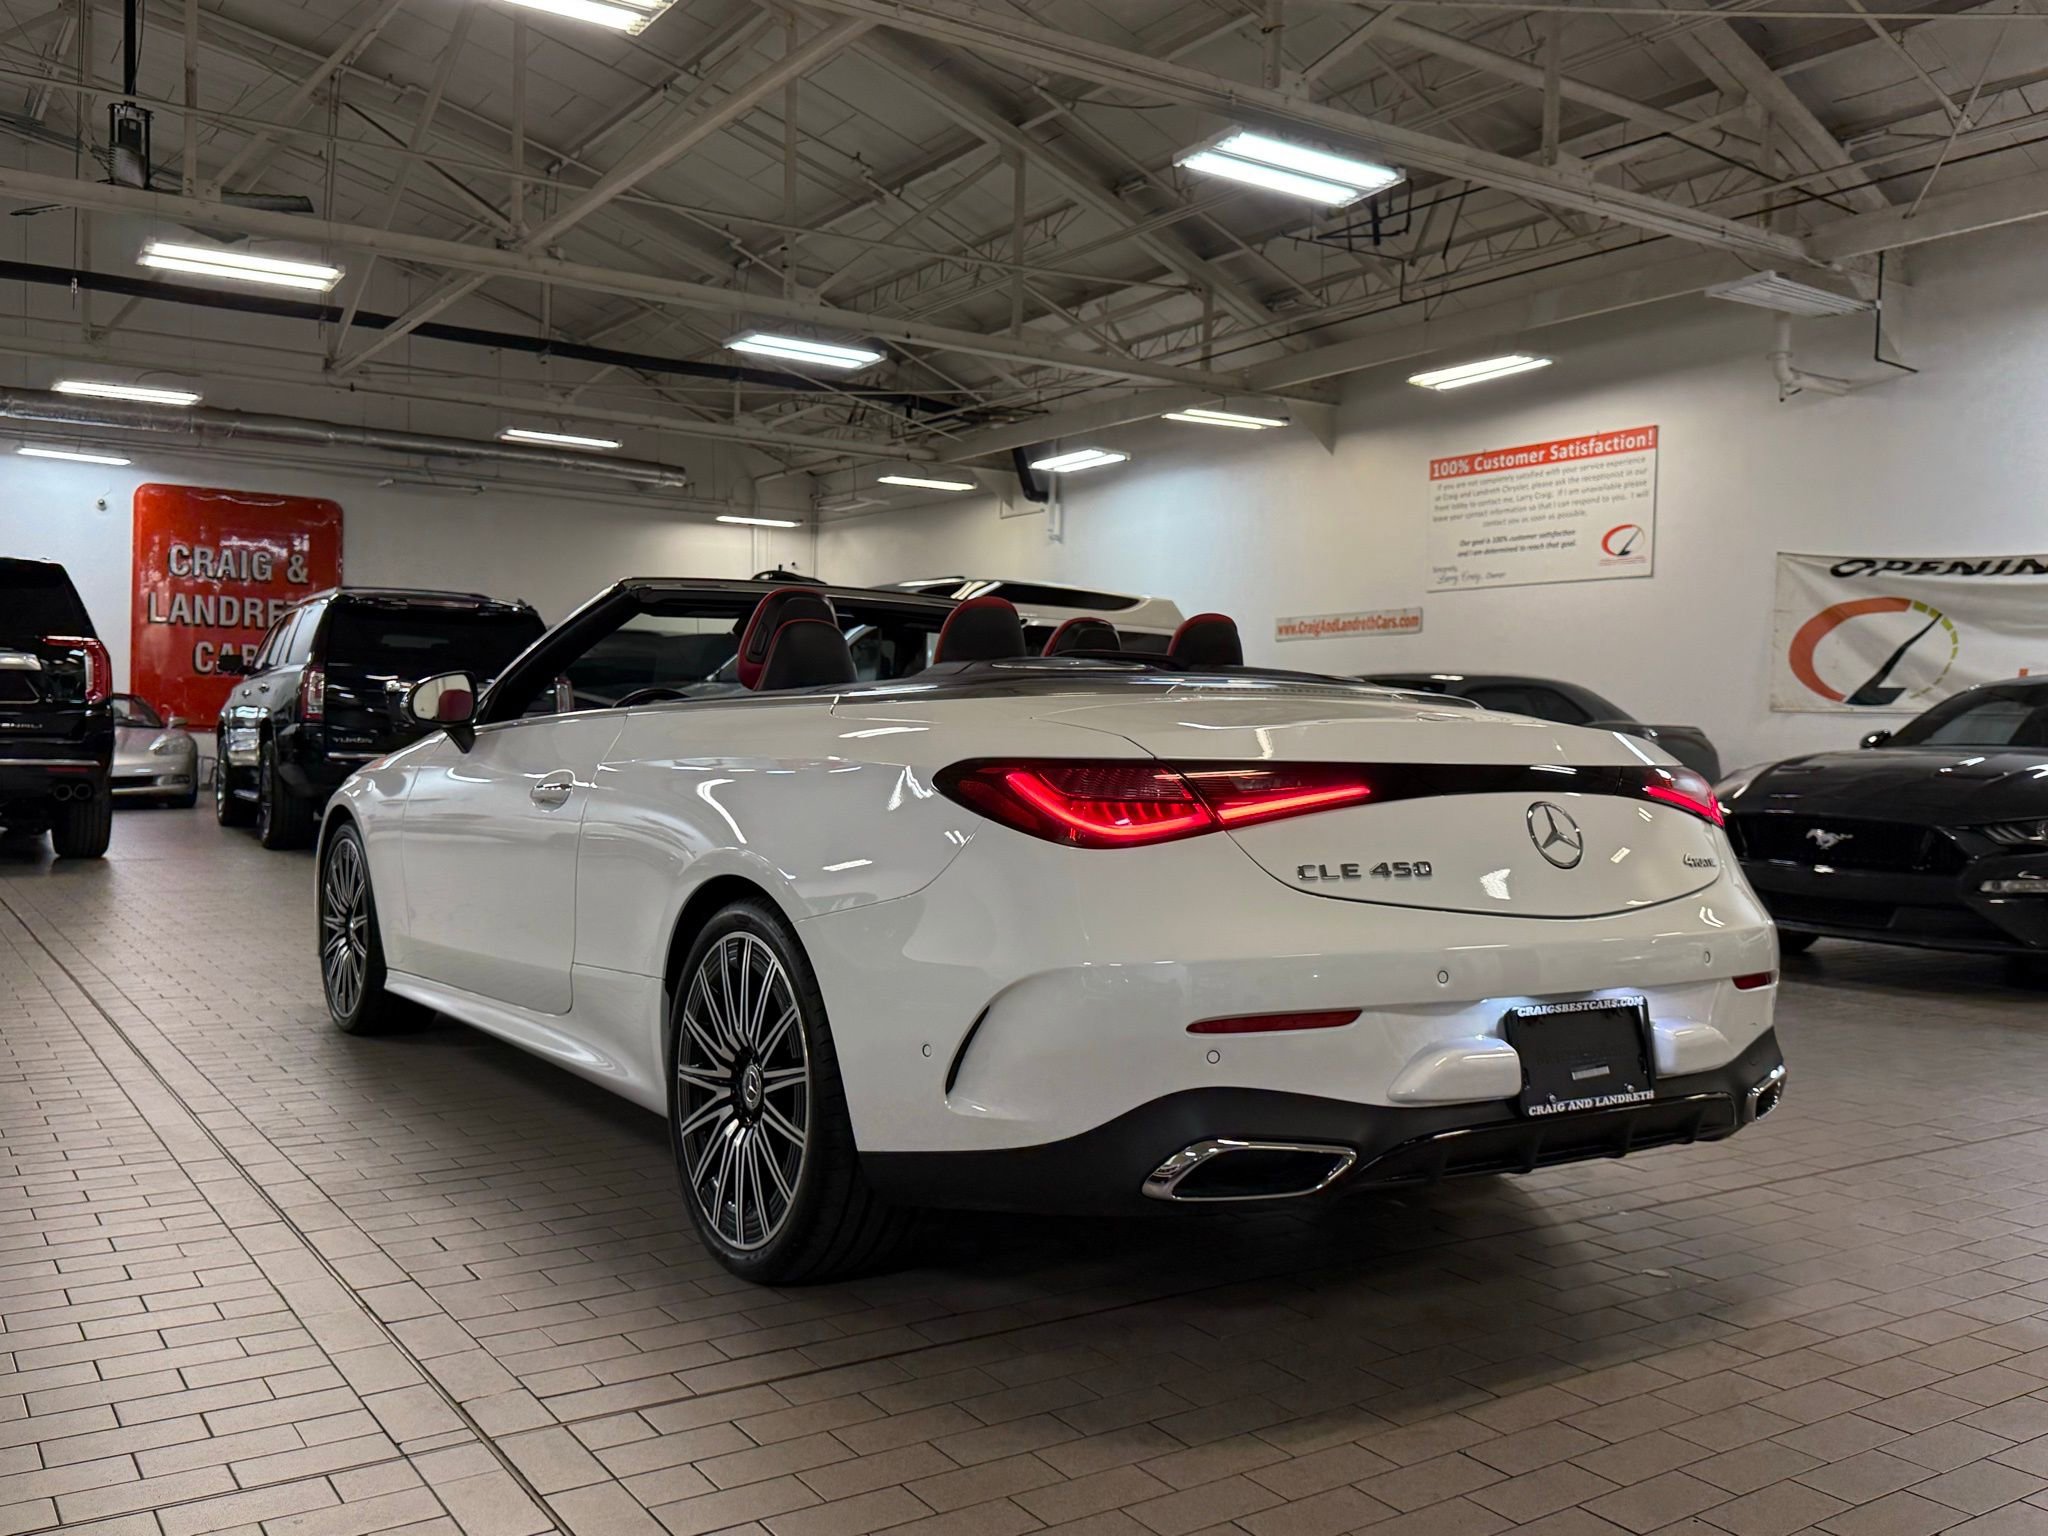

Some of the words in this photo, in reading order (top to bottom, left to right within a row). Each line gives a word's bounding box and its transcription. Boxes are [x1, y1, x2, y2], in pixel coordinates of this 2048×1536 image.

[1433, 459, 1470, 477] 100%
[1474, 450, 1545, 472] Customer
[1550, 431, 1653, 460] Satisfaction!
[168, 543, 273, 583] CRAIG
[286, 554, 309, 584] &
[148, 591, 300, 629] LANDRE
[1298, 863, 1361, 880] CLE
[1369, 861, 1433, 879] 450
[1517, 995, 1645, 1018] CRAIGSBESTCARS.COM
[1528, 1104, 1565, 1116] CRAIG
[1568, 1099, 1593, 1111] AND
[1595, 1089, 1655, 1106] LANDRETH
